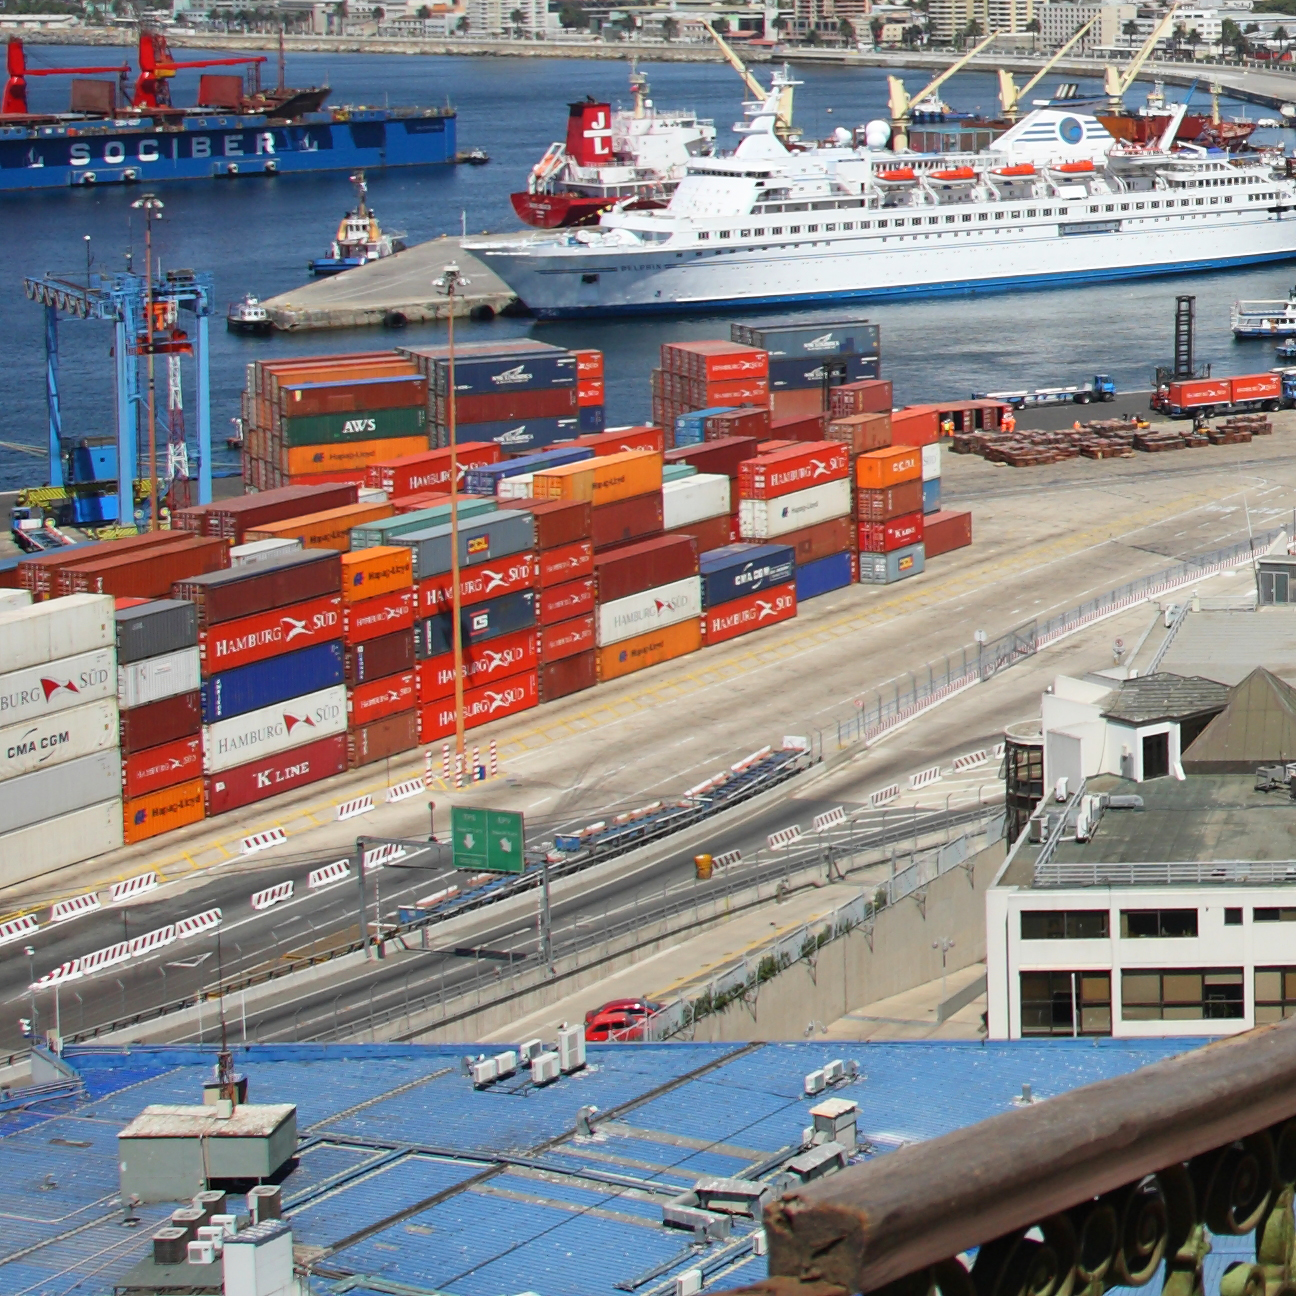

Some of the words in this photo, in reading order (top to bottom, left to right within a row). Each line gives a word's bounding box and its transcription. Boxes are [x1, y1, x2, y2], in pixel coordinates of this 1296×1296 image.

[591, 112, 605, 129] J
[70, 132, 276, 166] SOCIBER
[342, 419, 376, 434] AWS
[771, 465, 811, 486] HAMBURG
[426, 579, 483, 605] HAMURG
[509, 565, 530, 582] SÜD
[734, 572, 752, 586] CMA
[613, 605, 657, 627] HAMBURG
[671, 595, 688, 611] SÜD
[712, 608, 757, 632] HAMBURG
[776, 595, 793, 611] SÜD
[216, 626, 282, 657] HAMBURG
[313, 611, 338, 630] SÜD
[503, 647, 524, 666] SÜD
[80, 668, 108, 688] SÜD
[505, 687, 525, 705] SÜD
[218, 722, 283, 754] HAMBURG
[315, 704, 340, 723] SÜD
[7, 741, 37, 759] CMA
[40, 730, 71, 750] CGM
[253, 768, 275, 789] K
[276, 761, 310, 783] LINE
[152, 795, 201, 817] Hapag-Lloyd
